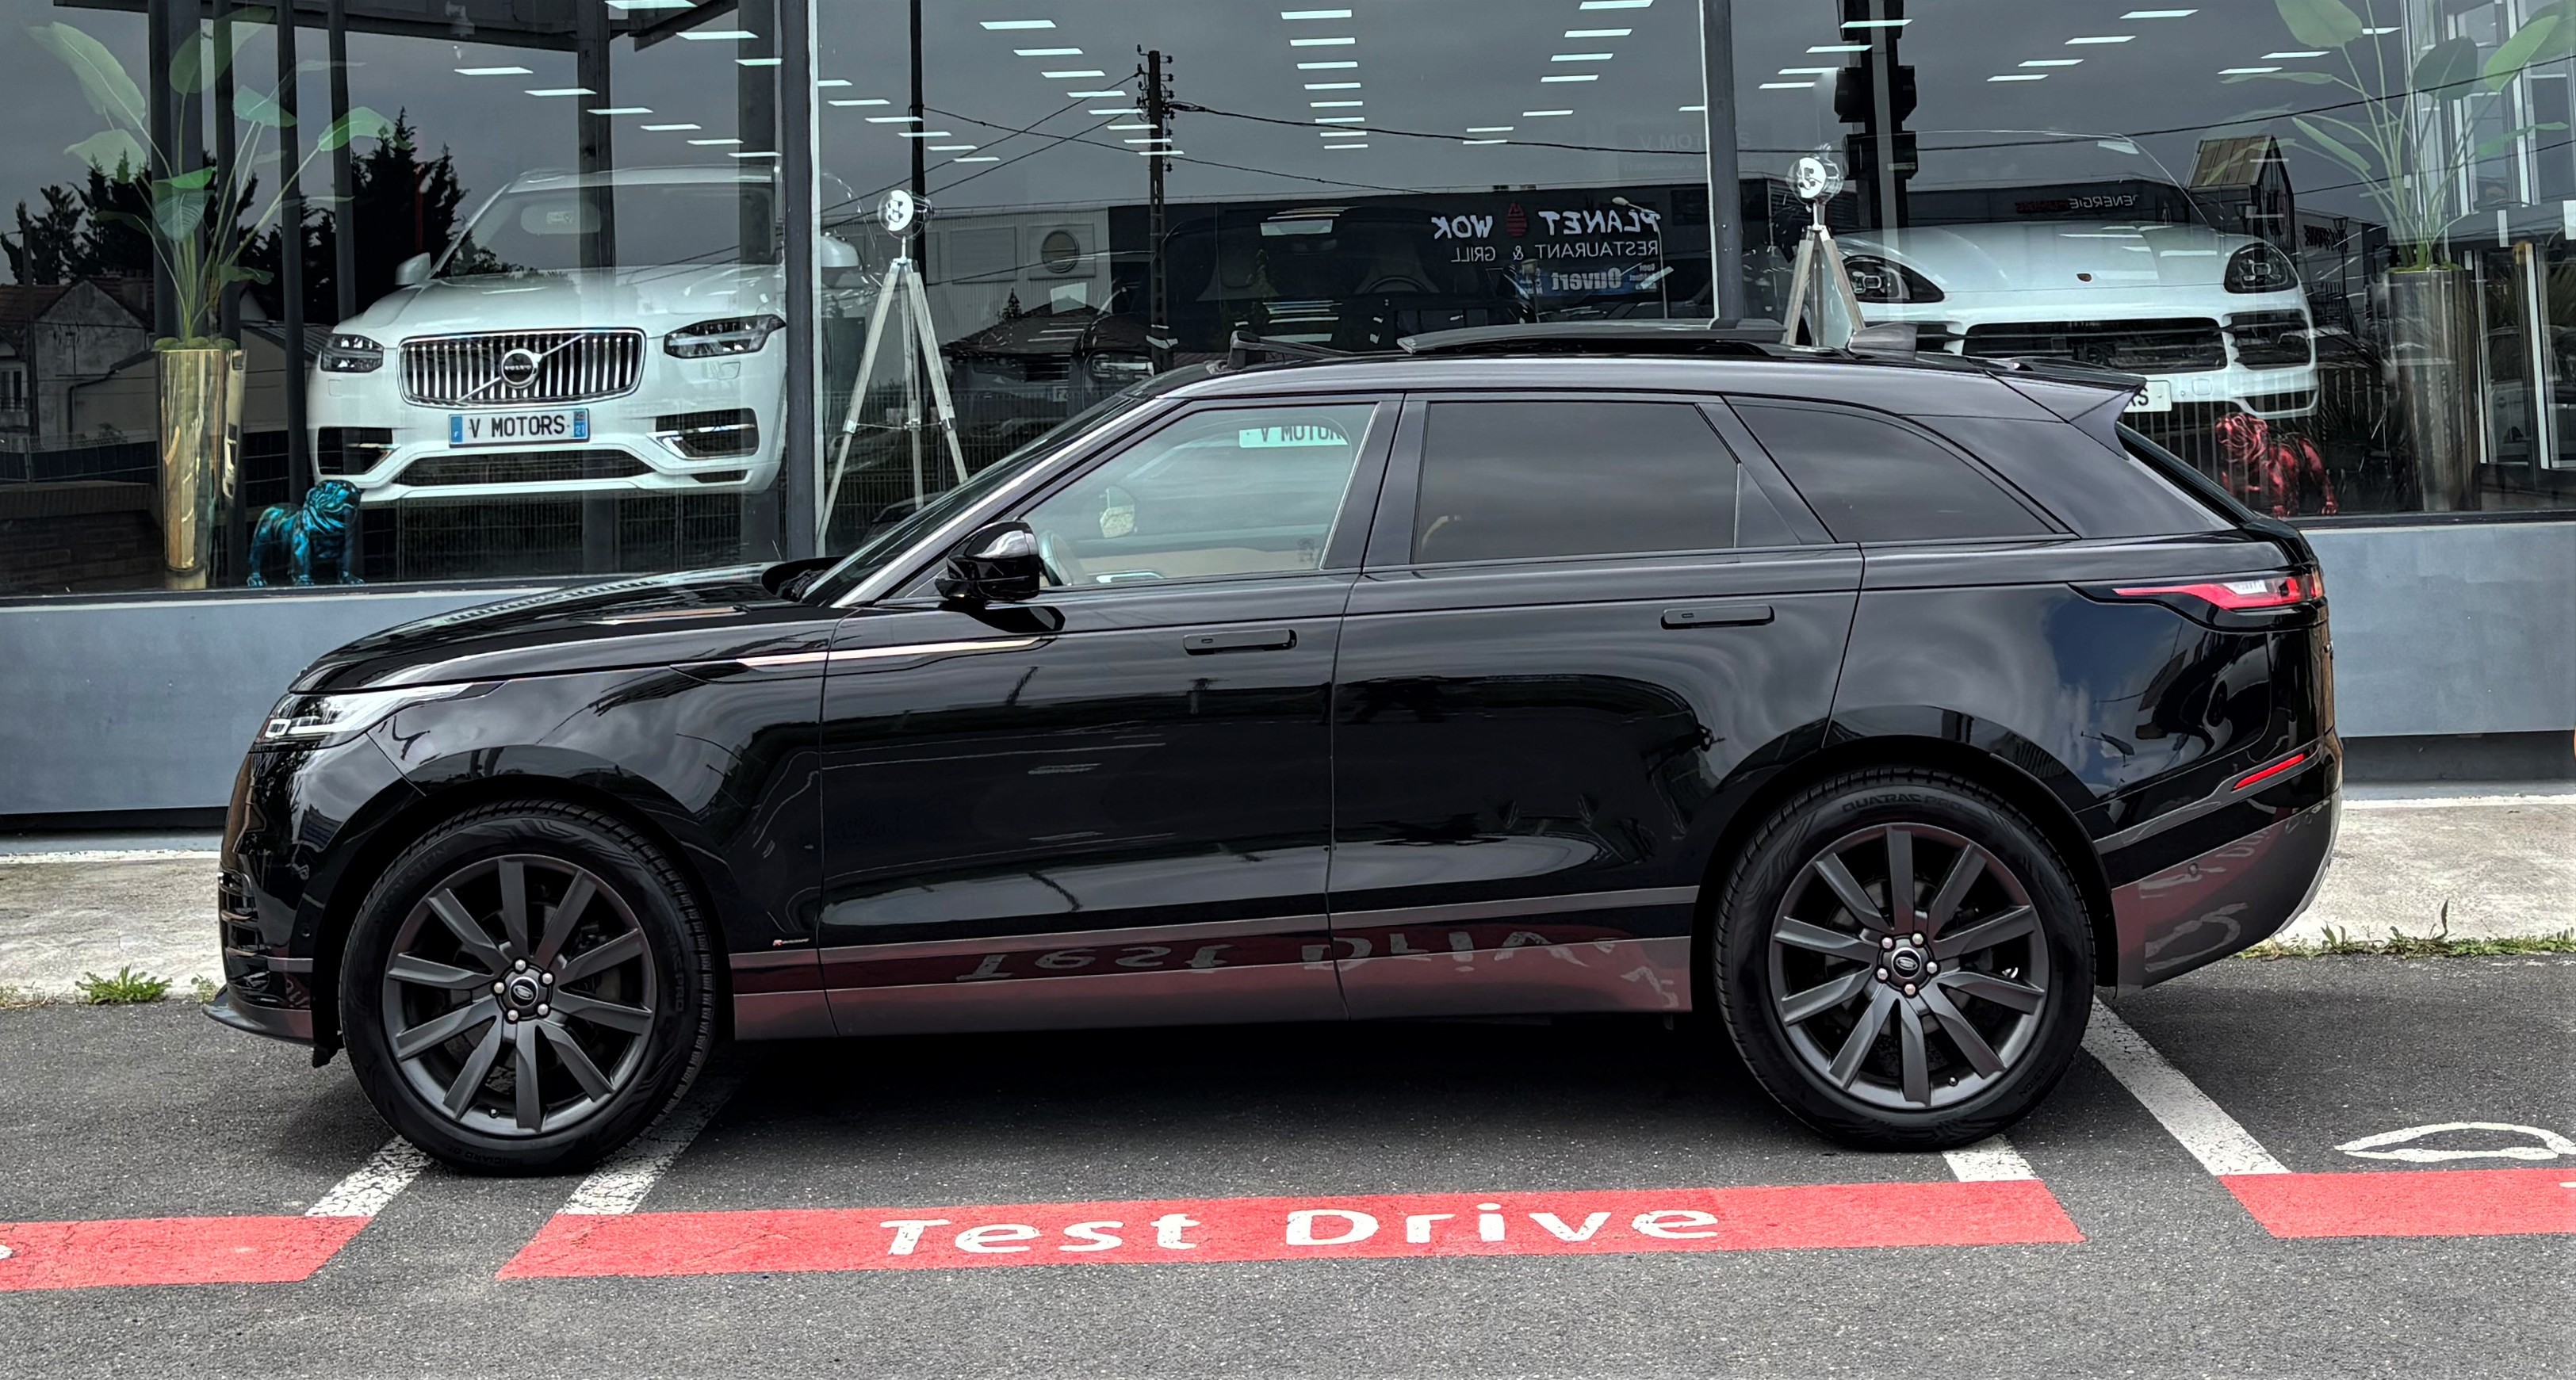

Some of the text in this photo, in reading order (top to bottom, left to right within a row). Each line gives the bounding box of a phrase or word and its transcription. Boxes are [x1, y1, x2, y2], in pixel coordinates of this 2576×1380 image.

[469, 418, 480, 438] V
[491, 415, 565, 438] MOTORS
[1842, 793, 1922, 813] QUATRAC
[878, 1202, 1719, 1255] Test Drive
